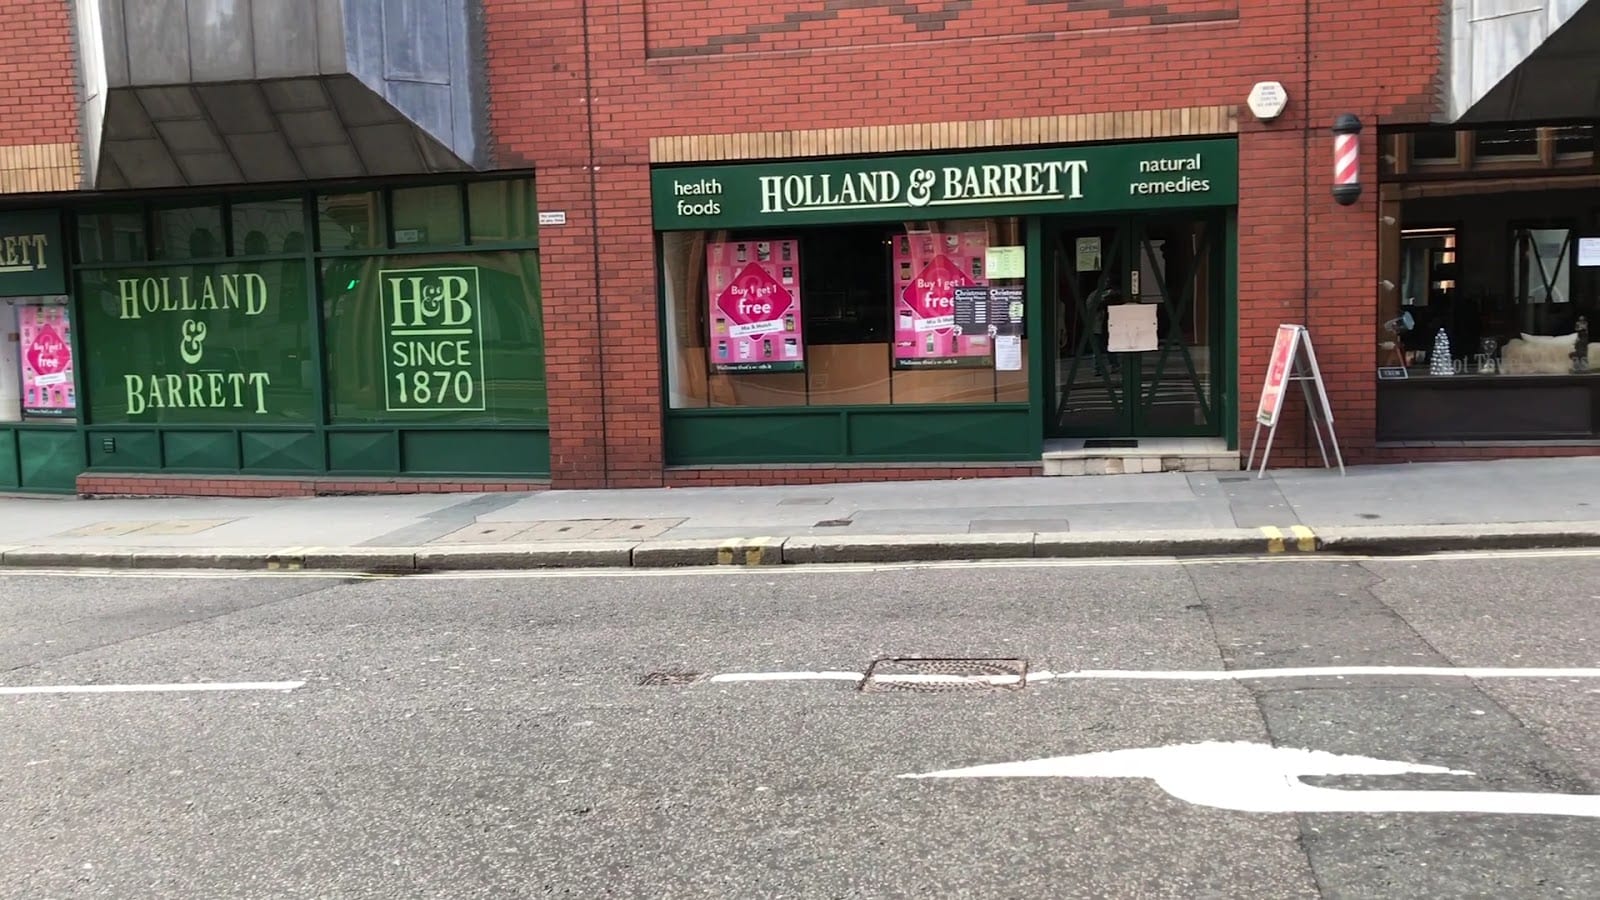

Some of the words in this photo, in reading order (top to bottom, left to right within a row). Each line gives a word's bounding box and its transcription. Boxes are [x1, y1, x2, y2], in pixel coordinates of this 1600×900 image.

[1140, 153, 1201, 173] natural
[674, 178, 722, 196] health
[759, 171, 900, 213] HOLLAND
[907, 168, 936, 207] &
[942, 160, 1088, 200] BARRETT
[1130, 176, 1210, 195] remedies
[677, 200, 721, 216] foods
[731, 286, 748, 297] Buy
[750, 285, 754, 294] 1
[756, 286, 771, 298] get
[772, 284, 777, 294] 1
[917, 279, 935, 291] Buy
[937, 278, 941, 287] 1
[943, 280, 959, 290] get
[961, 277, 965, 287] 1
[117, 273, 268, 319] HOLLAND
[388, 276, 472, 326] H&B
[738, 298, 771, 314] free
[180, 319, 207, 364] &
[38, 353, 58, 368] free
[393, 340, 472, 367] SINCE
[124, 372, 270, 414] BARRETT
[395, 370, 473, 403] 1870
